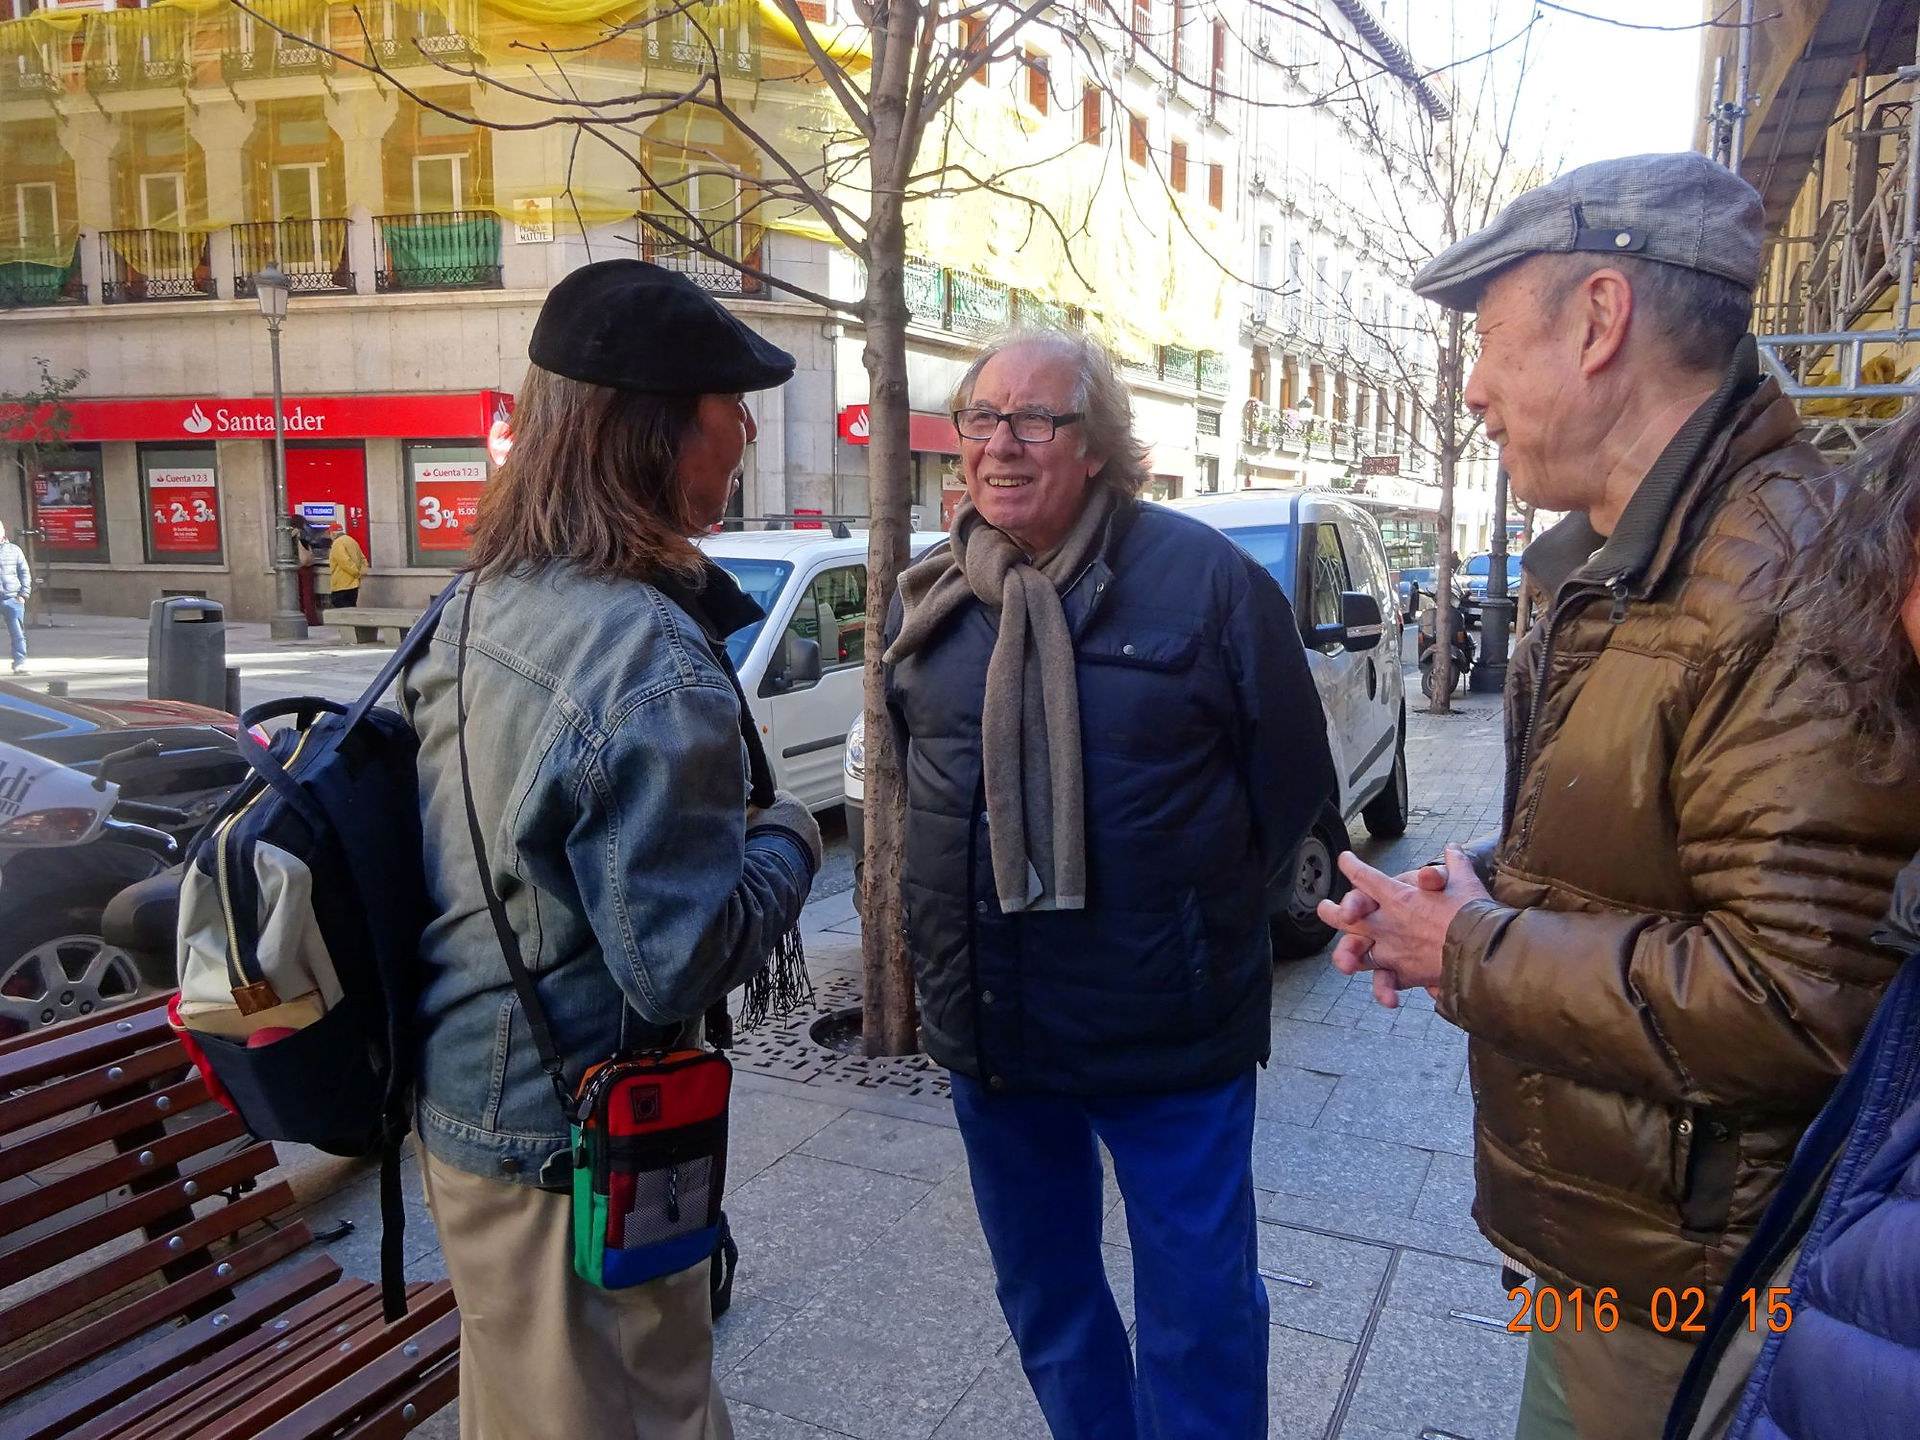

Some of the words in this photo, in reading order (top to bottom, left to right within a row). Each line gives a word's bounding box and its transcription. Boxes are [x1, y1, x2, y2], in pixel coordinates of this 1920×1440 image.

[216, 406, 325, 431] Santander
[433, 468, 461, 477] Cuenta
[166, 474, 191, 483] Cuenta
